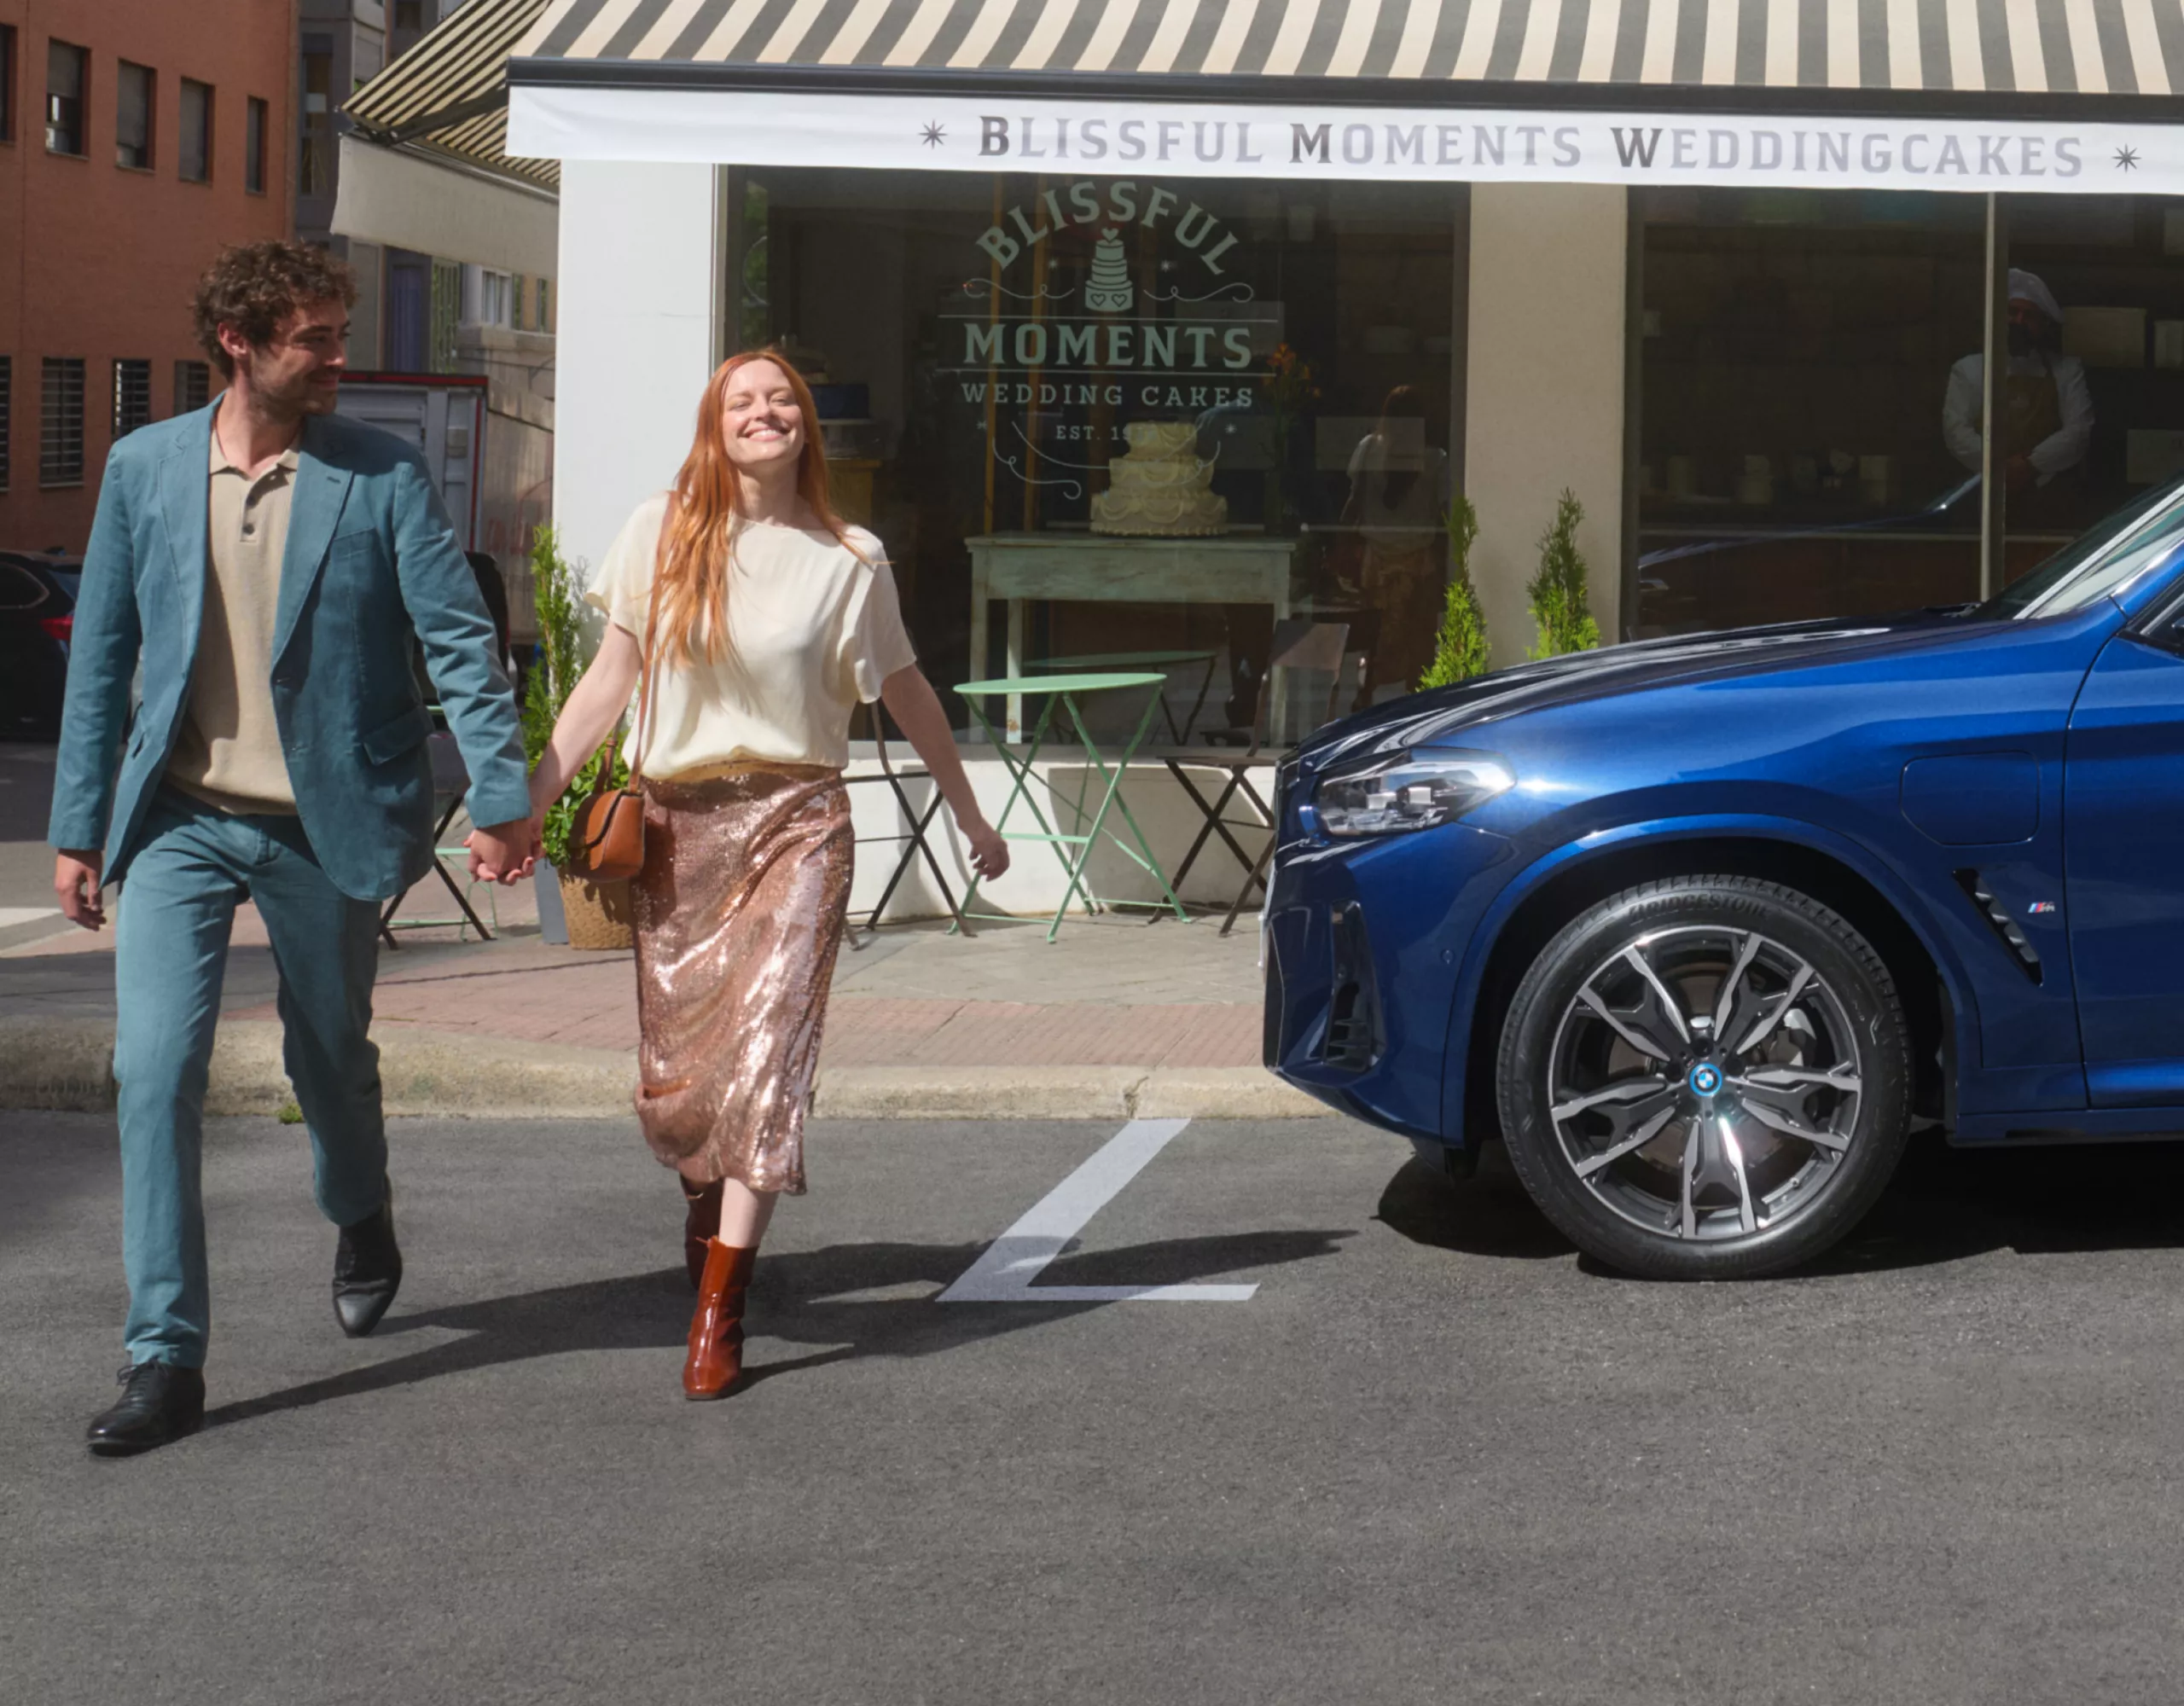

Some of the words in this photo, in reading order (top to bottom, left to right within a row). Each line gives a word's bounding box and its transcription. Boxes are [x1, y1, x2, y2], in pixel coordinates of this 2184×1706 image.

[979, 115, 1263, 164] BLISSFUL
[1289, 122, 1582, 168] MOMENTS
[1611, 126, 2083, 177] WEDDINGCAKES
[974, 180, 1240, 276] BLISSFUL
[963, 322, 1252, 369] MOMENTS
[961, 383, 1124, 406] WEDDING
[1141, 386, 1253, 408] CAKES
[1055, 425, 1101, 440] EST.
